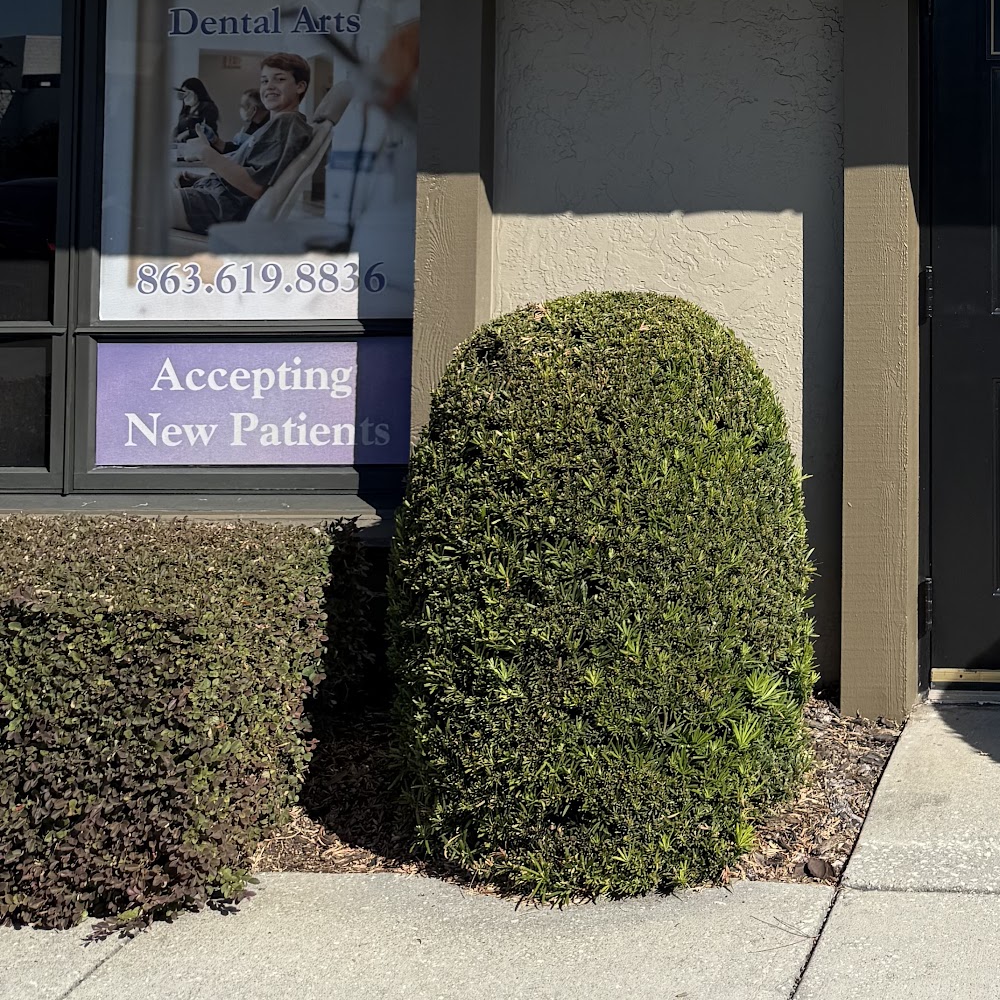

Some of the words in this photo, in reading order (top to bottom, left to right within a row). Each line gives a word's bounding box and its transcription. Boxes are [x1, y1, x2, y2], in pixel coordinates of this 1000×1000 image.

[168, 5, 281, 36] Dental
[291, 5, 361, 34] Arts
[137, 262, 386, 295] 863.619.8836
[151, 357, 353, 399] Accepting
[124, 412, 218, 447] New
[230, 411, 390, 447] Patients
